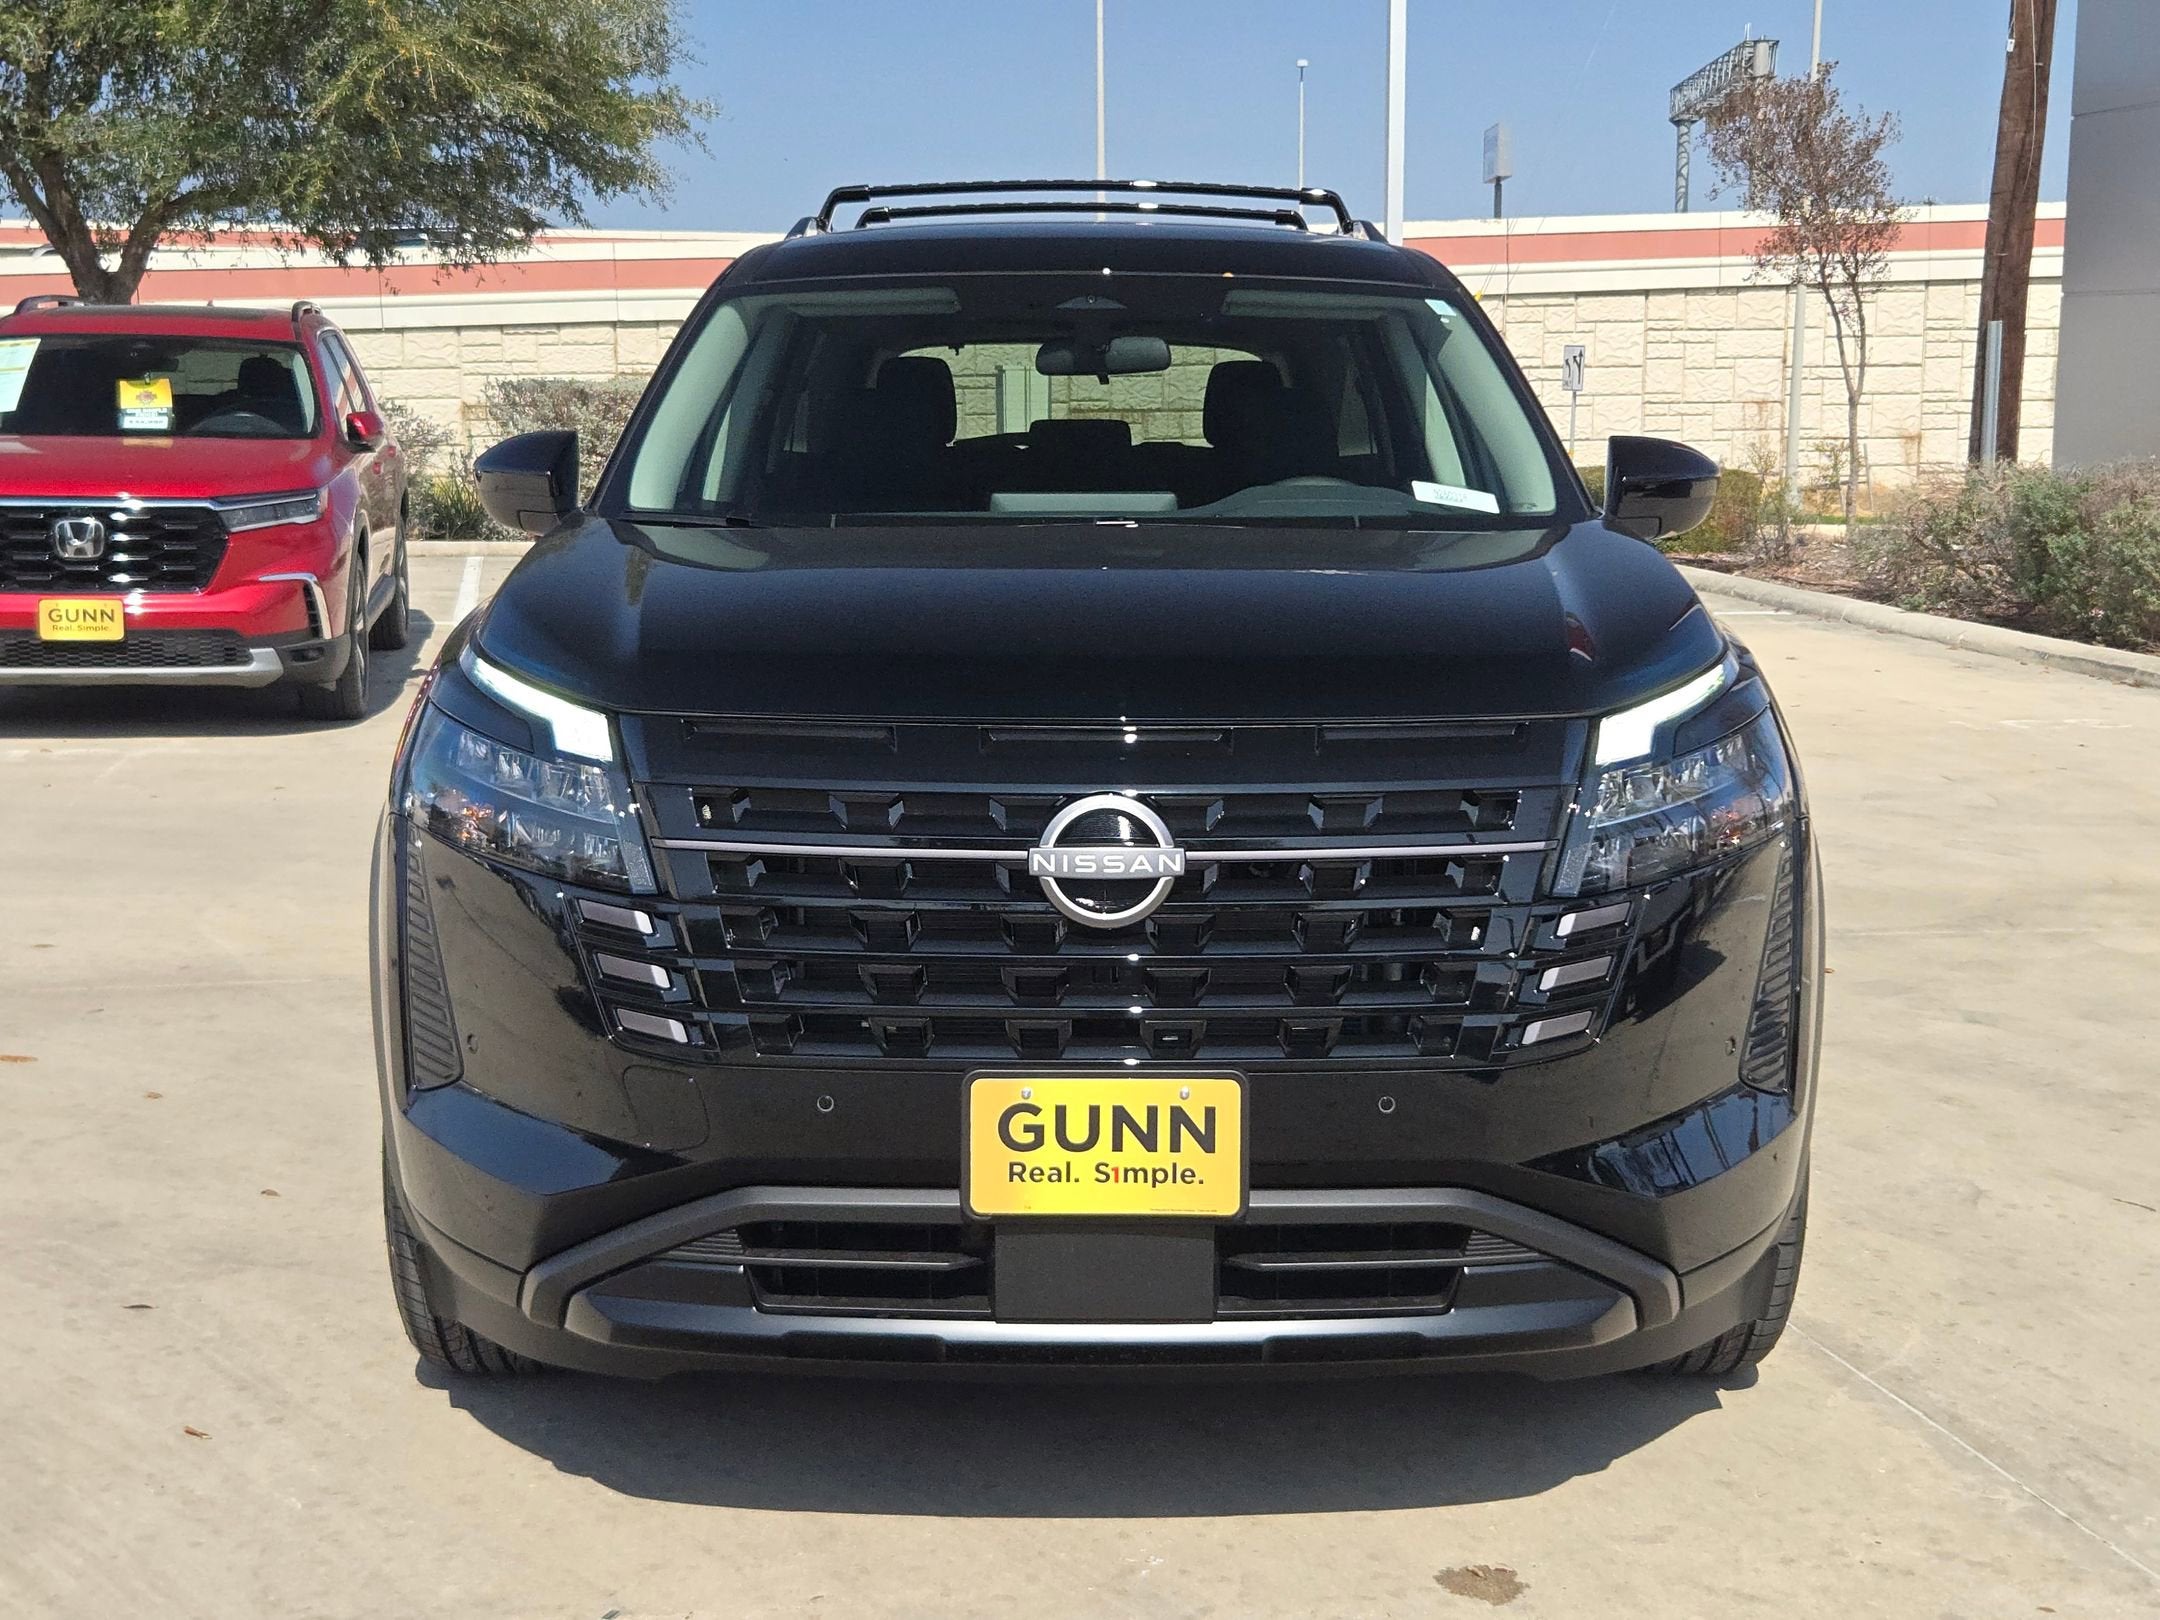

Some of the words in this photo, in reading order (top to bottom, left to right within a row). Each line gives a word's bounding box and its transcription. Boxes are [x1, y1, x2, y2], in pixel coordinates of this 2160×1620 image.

[48, 608, 115, 623] GUNN
[1033, 853, 1181, 873] NISSAN
[997, 1102, 1217, 1154] GUNN
[1008, 1161, 1080, 1184] Real.
